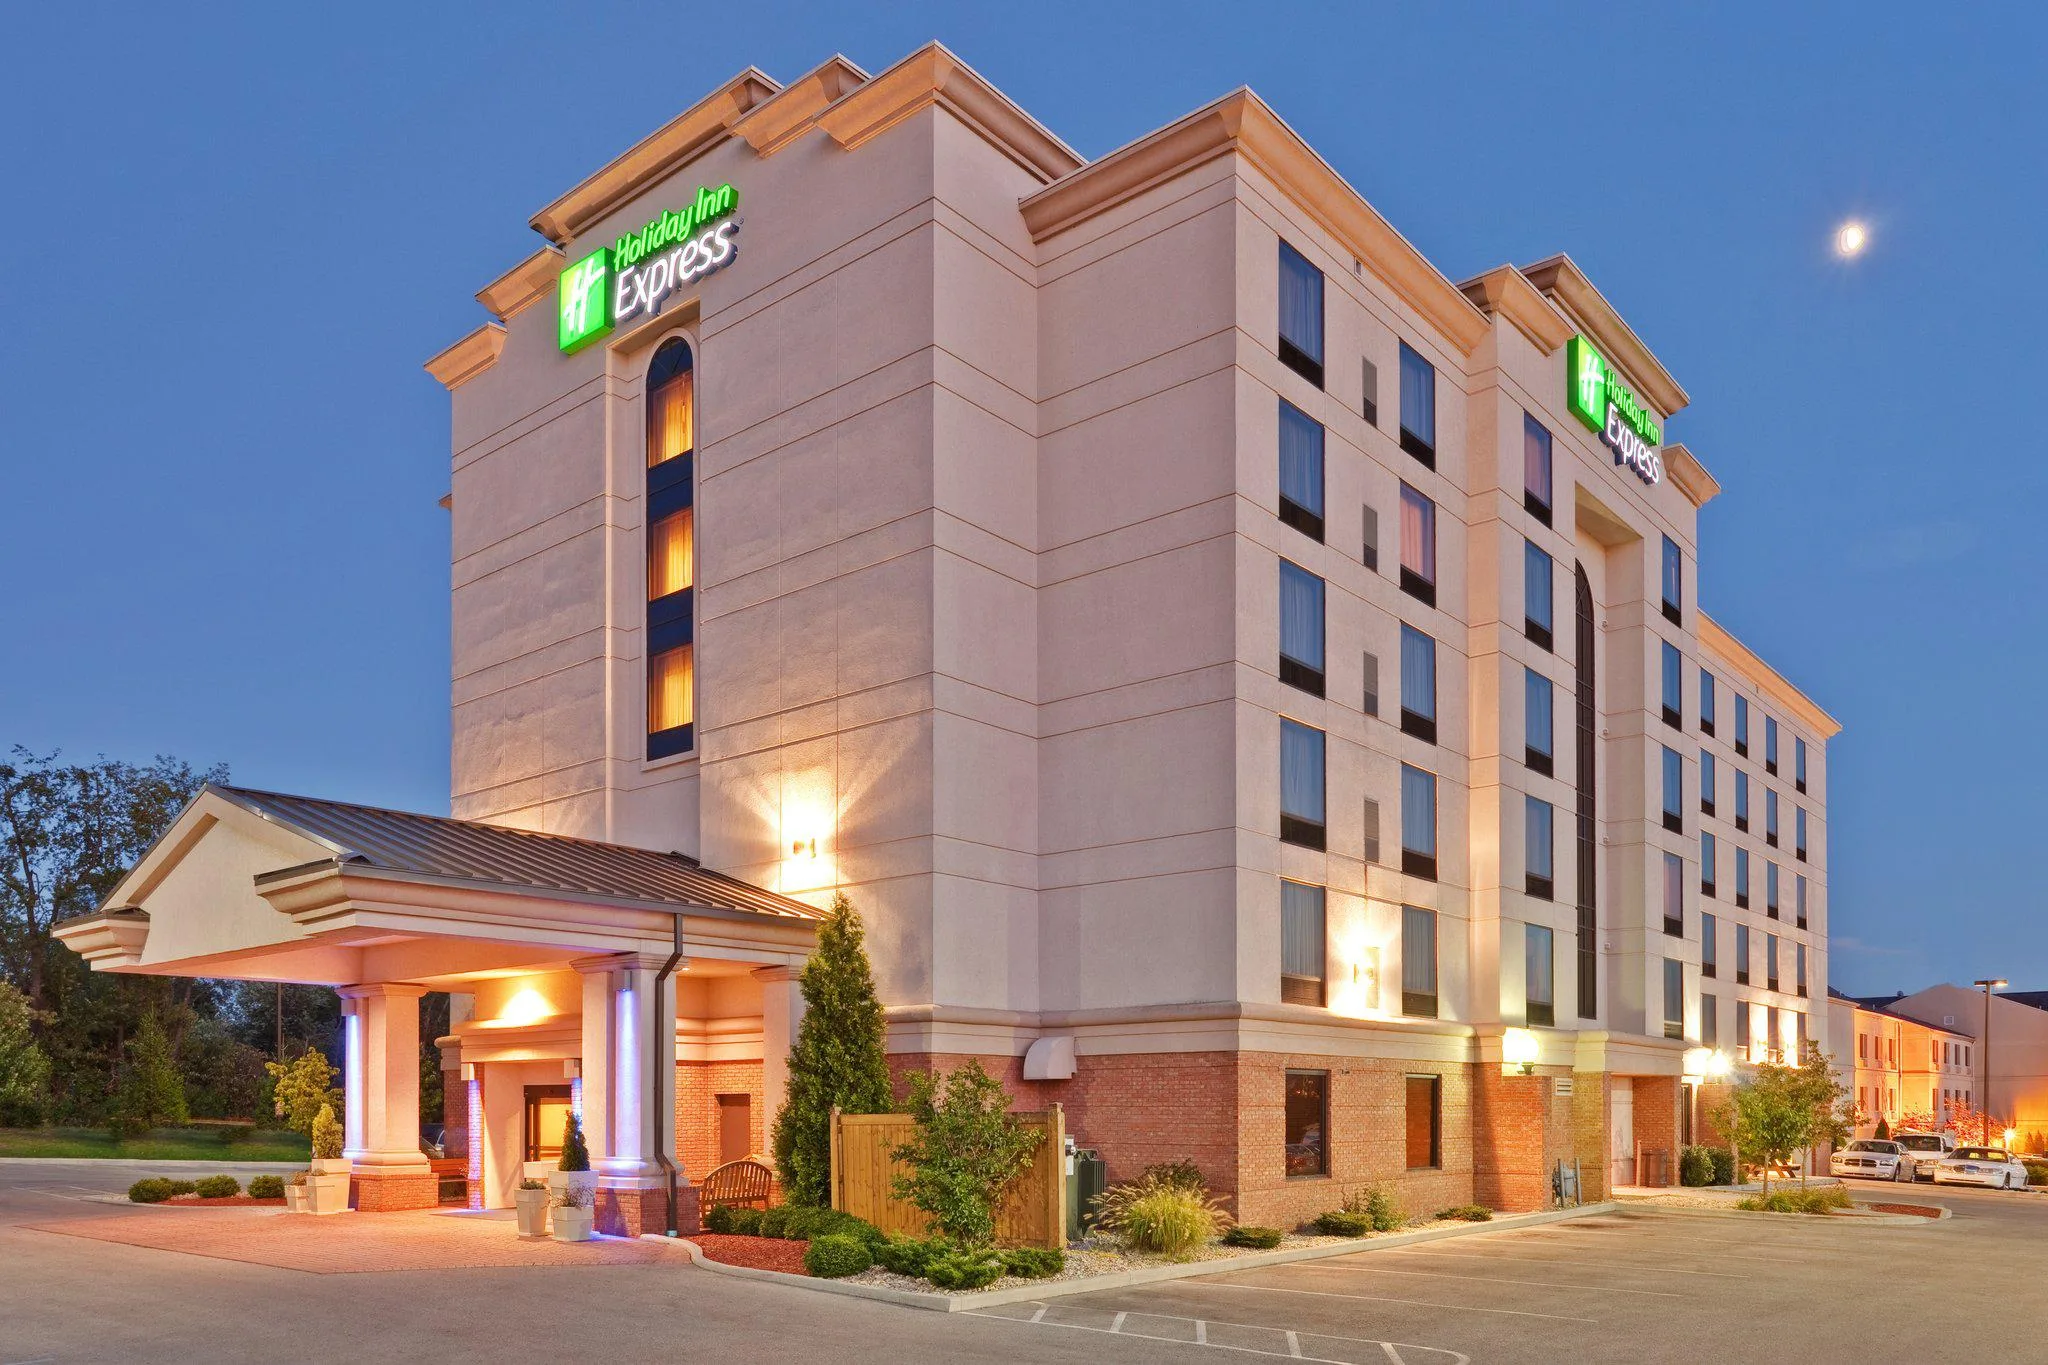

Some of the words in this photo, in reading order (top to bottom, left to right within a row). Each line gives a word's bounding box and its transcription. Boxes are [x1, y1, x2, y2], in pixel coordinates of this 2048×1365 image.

[613, 205, 694, 272] Holiday
[695, 183, 732, 224] Inn
[614, 221, 733, 320] Express
[1606, 368, 1644, 433] Holiday
[1644, 409, 1660, 446] Inn
[1607, 401, 1660, 484] Express
